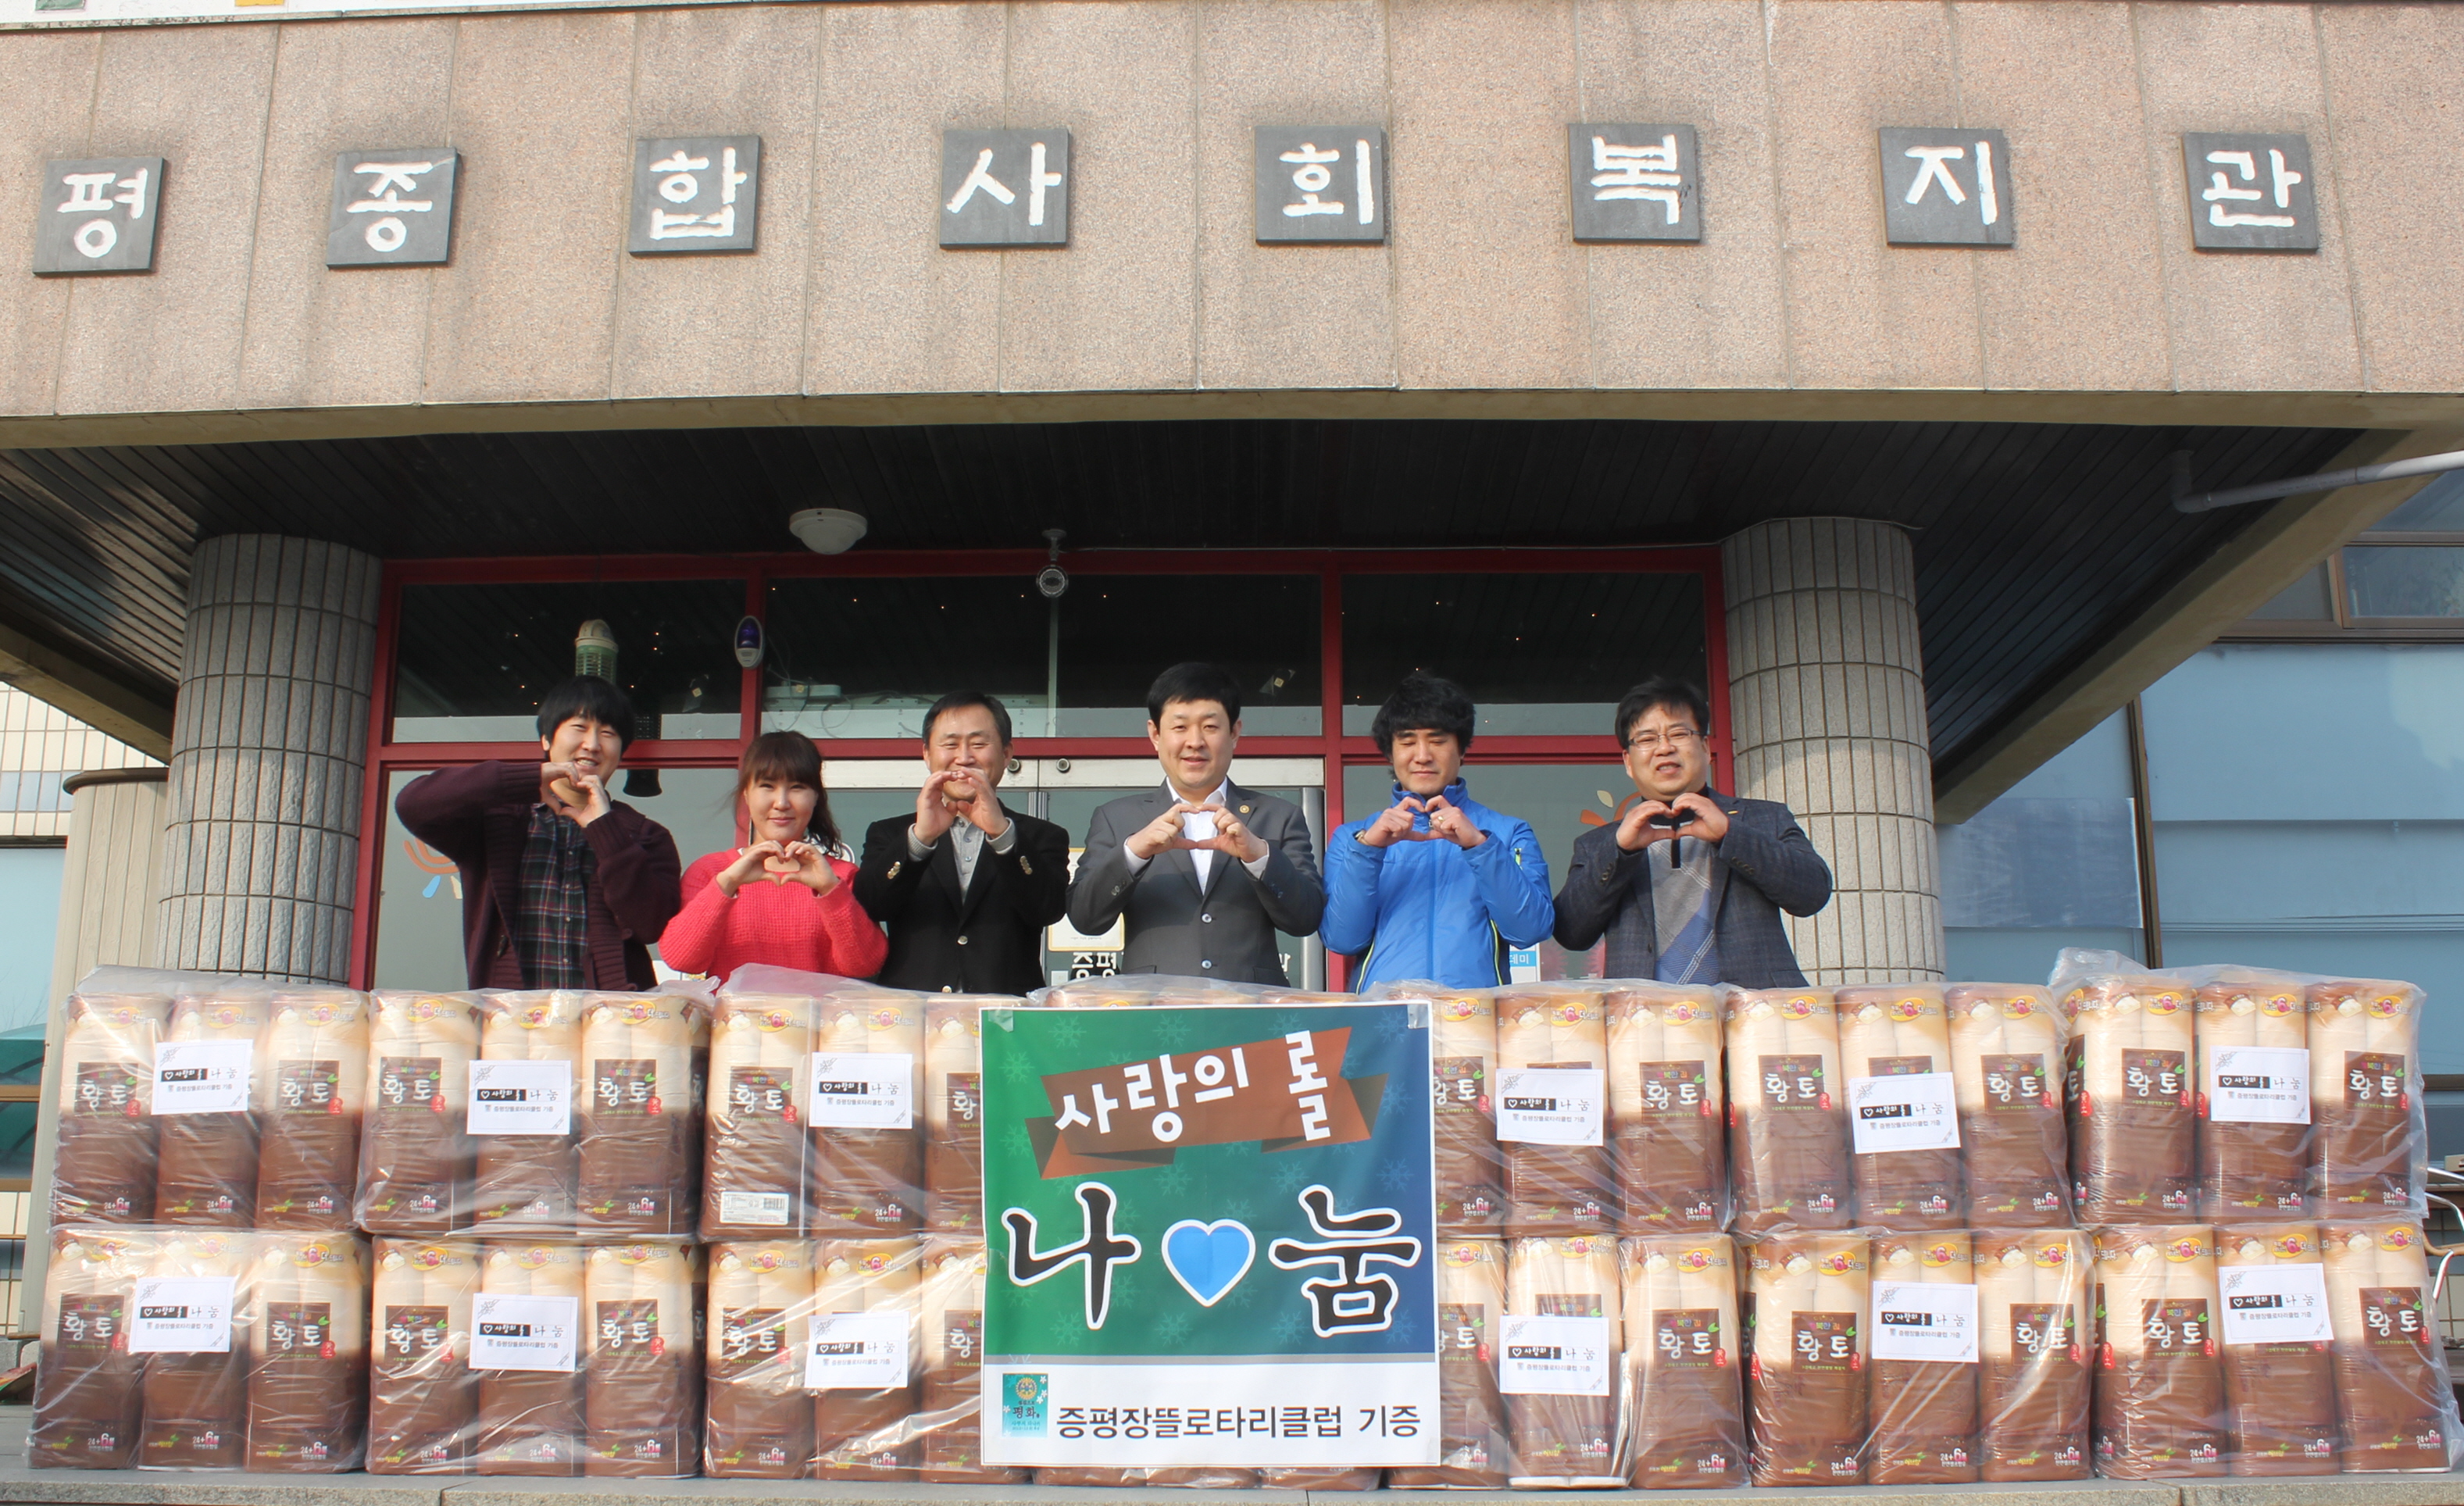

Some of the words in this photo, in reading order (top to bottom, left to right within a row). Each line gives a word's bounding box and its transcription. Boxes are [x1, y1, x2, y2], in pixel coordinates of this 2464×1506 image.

[1072, 952, 1123, 979] 증평
[1055, 1047, 1248, 1142] 사랑의
[1285, 1030, 1330, 1141] 롤
[952, 1090, 977, 1120] 황
[949, 1328, 974, 1358] 황
[1056, 1405, 1342, 1439] 증평장뜰로타리클럽
[1358, 1405, 1421, 1437] 기증
